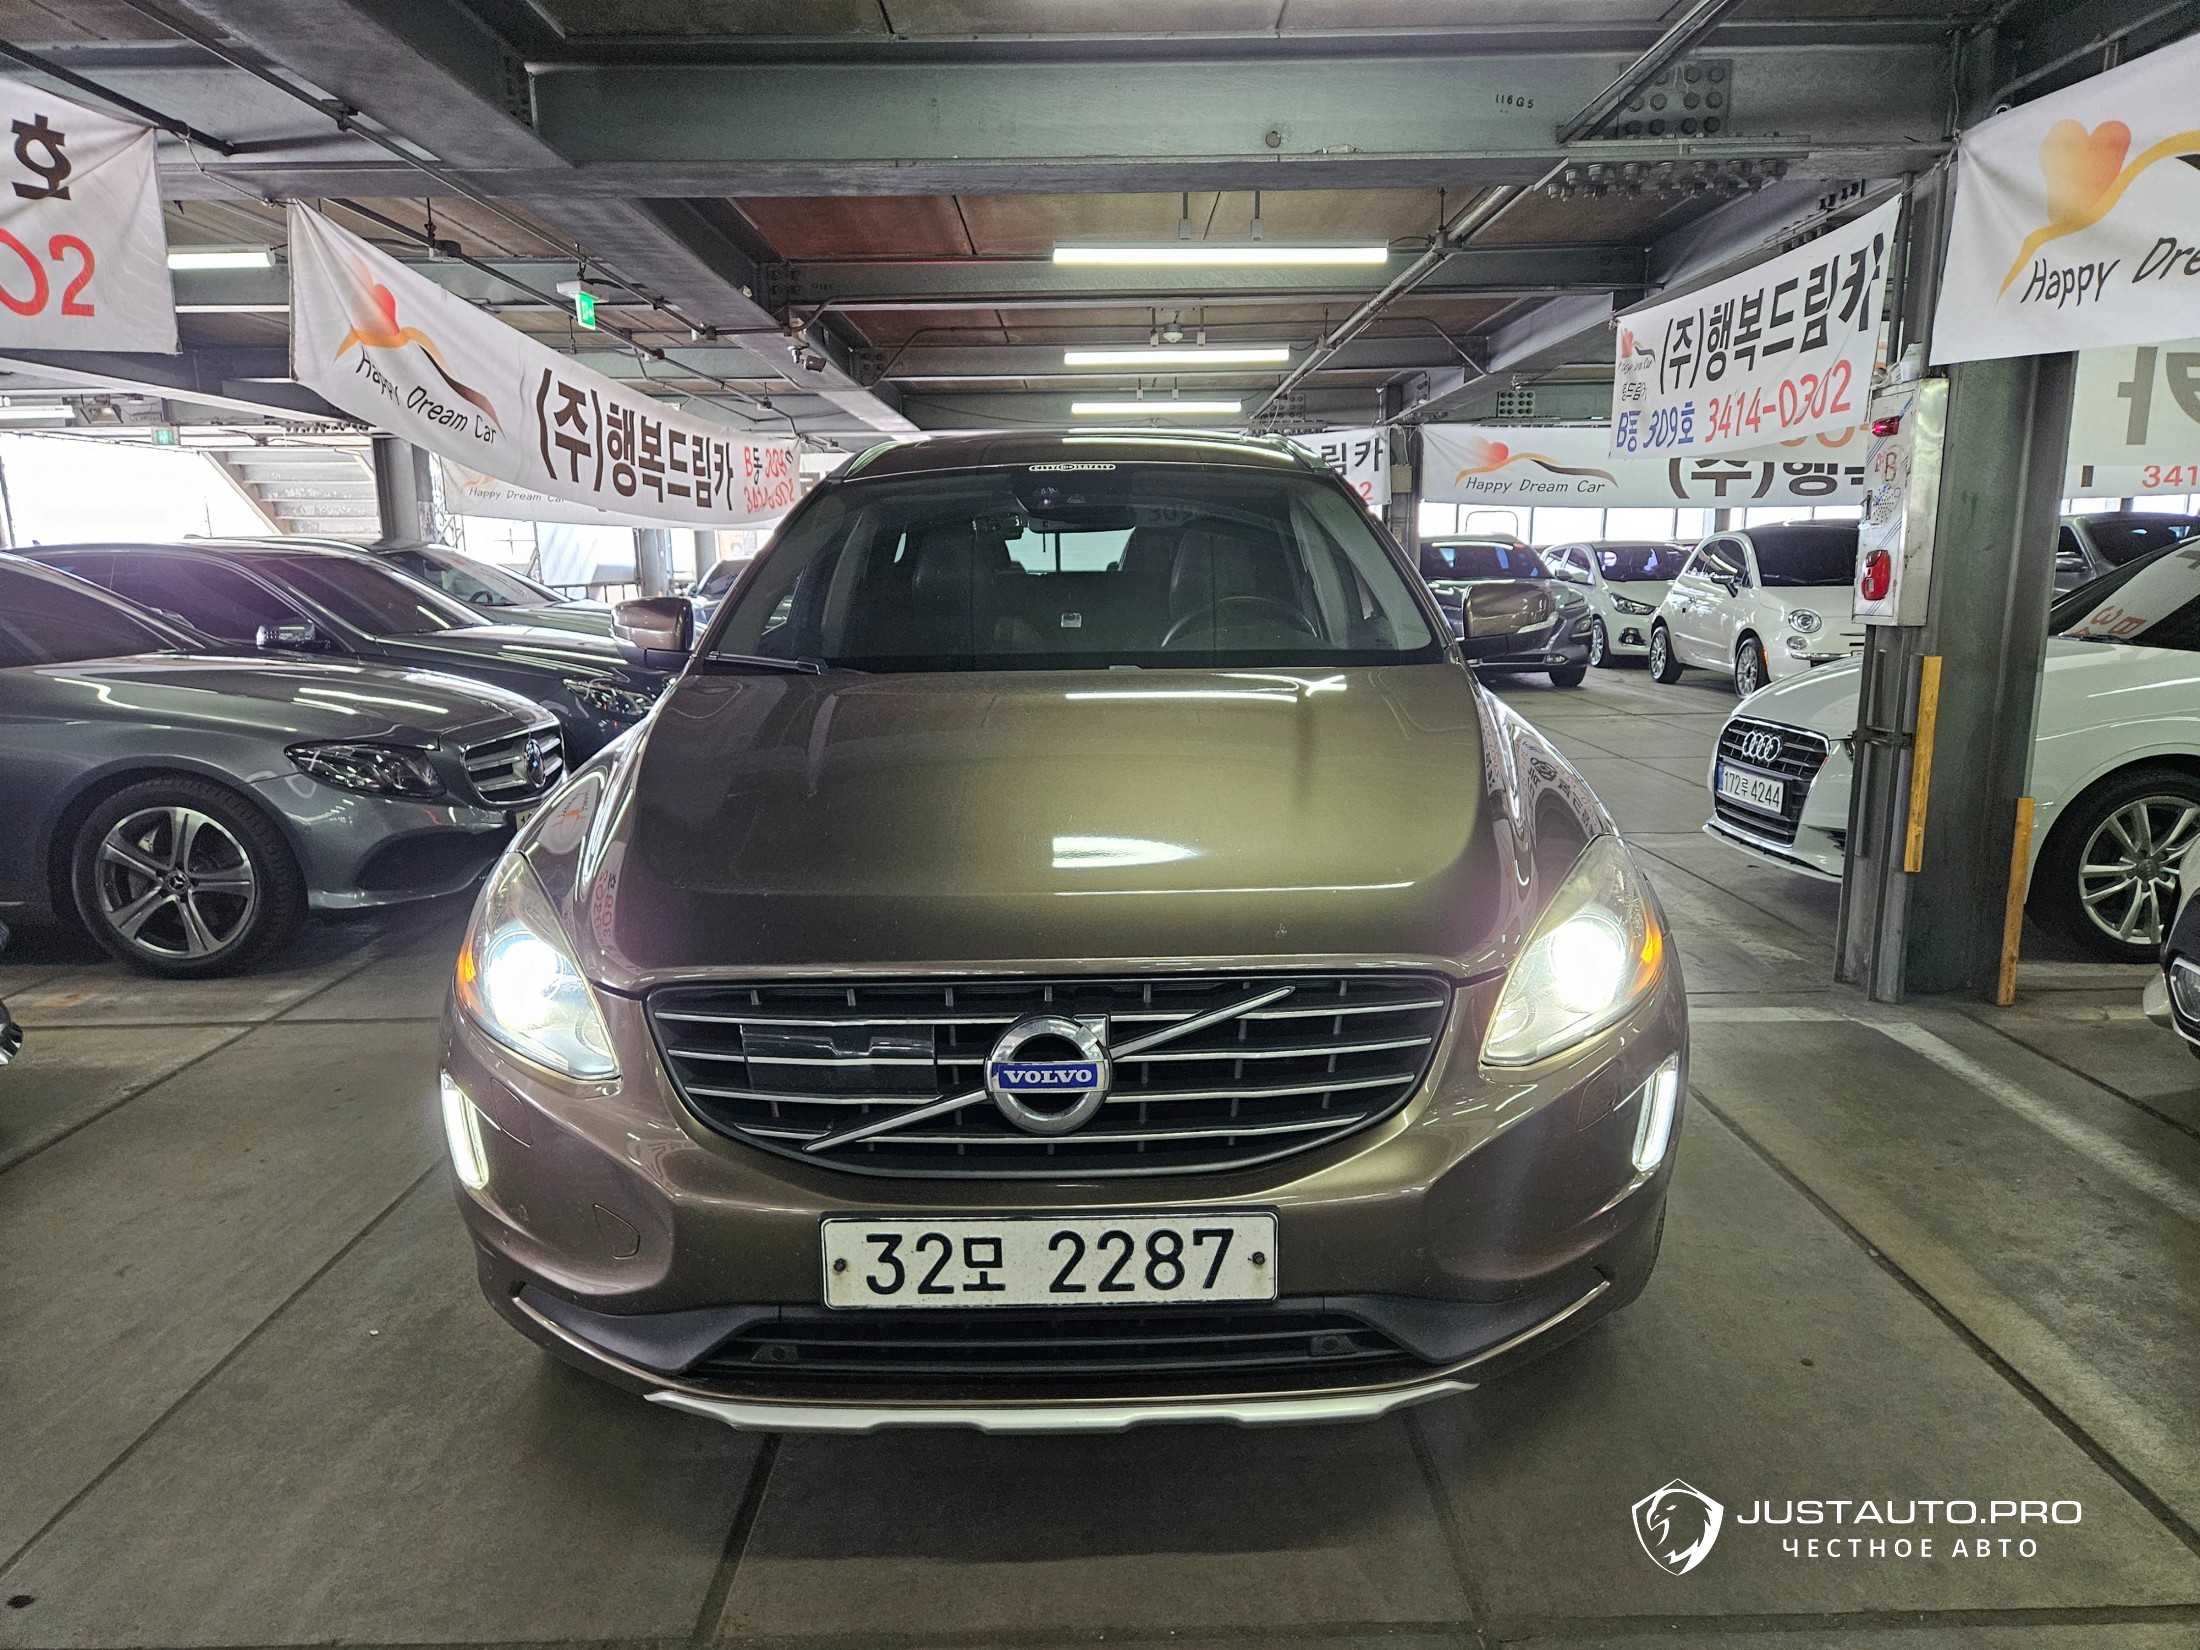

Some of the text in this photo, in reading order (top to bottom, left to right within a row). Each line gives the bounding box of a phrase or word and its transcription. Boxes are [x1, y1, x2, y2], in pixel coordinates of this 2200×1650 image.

[2020, 258, 2120, 309] Happy
[407, 386, 469, 432] Dream
[474, 414, 497, 444] Car
[1705, 359, 1851, 442] 3414-0302
[1616, 410, 1642, 453] B동
[469, 487, 502, 500] Happy
[506, 489, 542, 502] Dream
[1465, 476, 1606, 493] Happy Dream Car
[1724, 770, 1780, 808] 172루 4244
[1003, 1069, 1092, 1084] VOLVO
[865, 1228, 1234, 1295] 32모 2287
